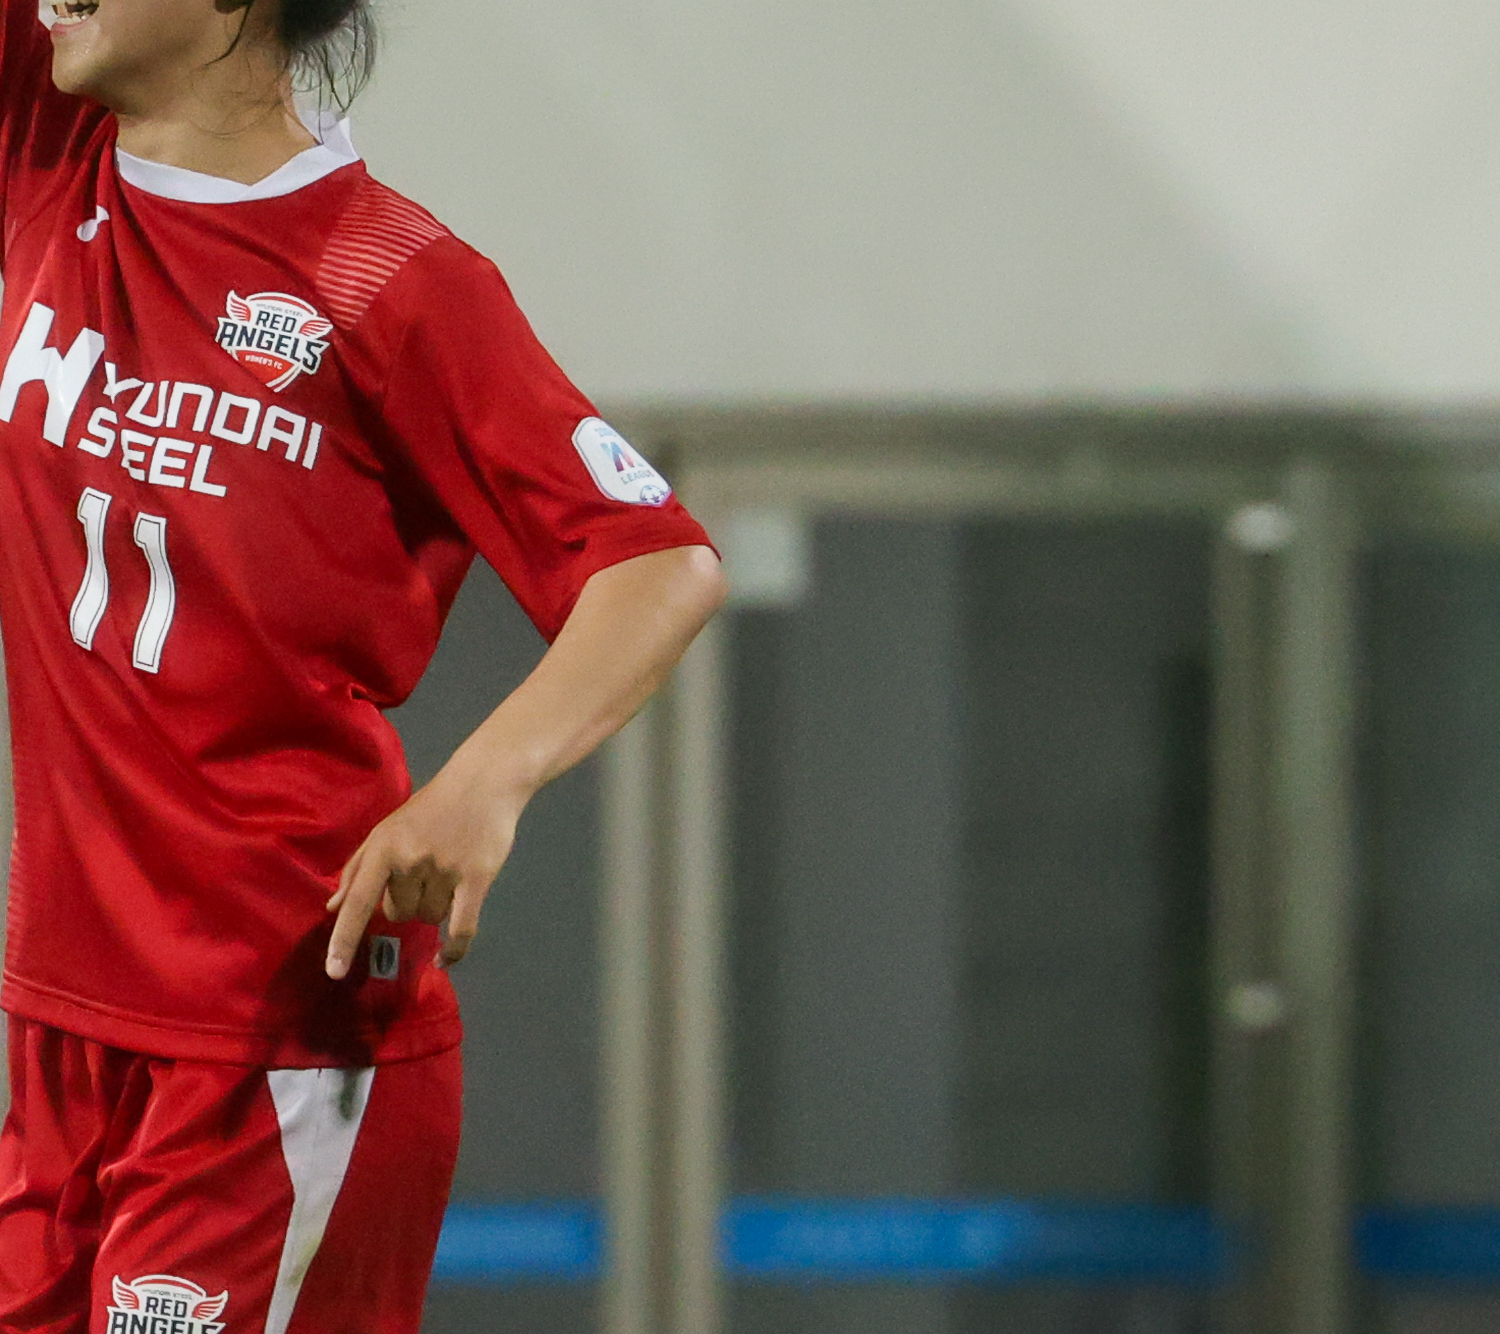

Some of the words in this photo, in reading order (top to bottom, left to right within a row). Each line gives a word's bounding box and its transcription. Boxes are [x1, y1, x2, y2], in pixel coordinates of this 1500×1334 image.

[255, 310, 297, 333] RED
[220, 322, 324, 371] ANGELS
[70, 487, 176, 673] 11
[145, 1296, 188, 1319] RED
